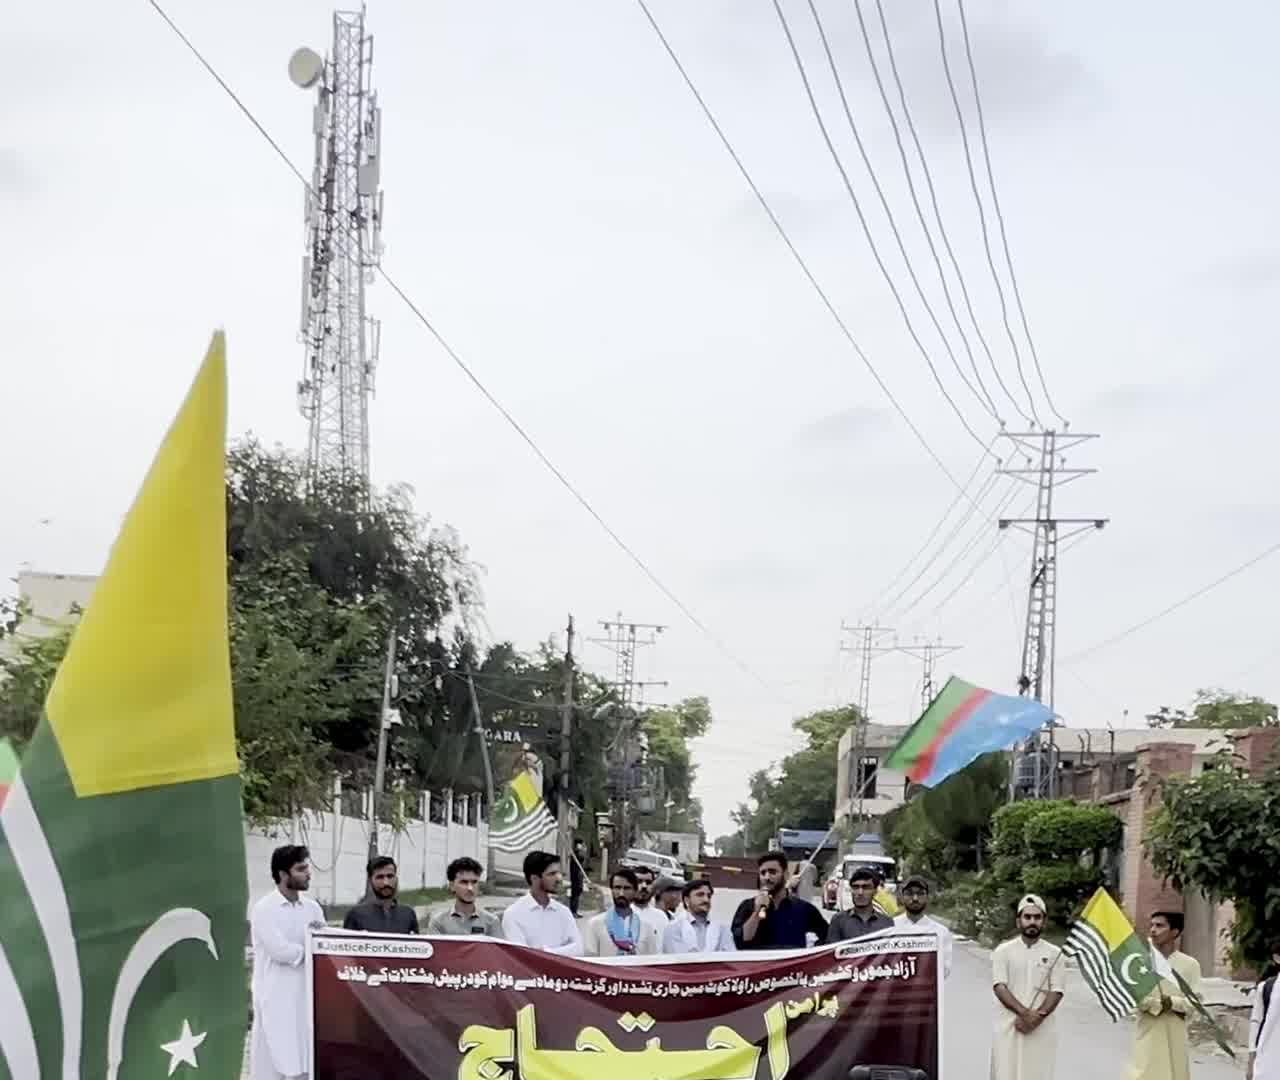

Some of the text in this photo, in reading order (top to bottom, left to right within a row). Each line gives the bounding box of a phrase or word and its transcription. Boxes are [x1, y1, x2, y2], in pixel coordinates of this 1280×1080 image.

[317, 942, 429, 954] #JusticeForKashmir
[336, 965, 367, 981] خلاف
[892, 956, 916, 979] آزاد
[367, 966, 388, 986] کے
[388, 967, 434, 985] مشکلات
[488, 971, 514, 989] عوام
[513, 975, 537, 991] سے
[755, 971, 809, 992] بالخصوص
[568, 977, 607, 994] گزشتہ
[607, 981, 622, 996] اور
[622, 980, 652, 994] تشدد
[652, 981, 680, 997] جاری
[680, 982, 706, 997] میں
